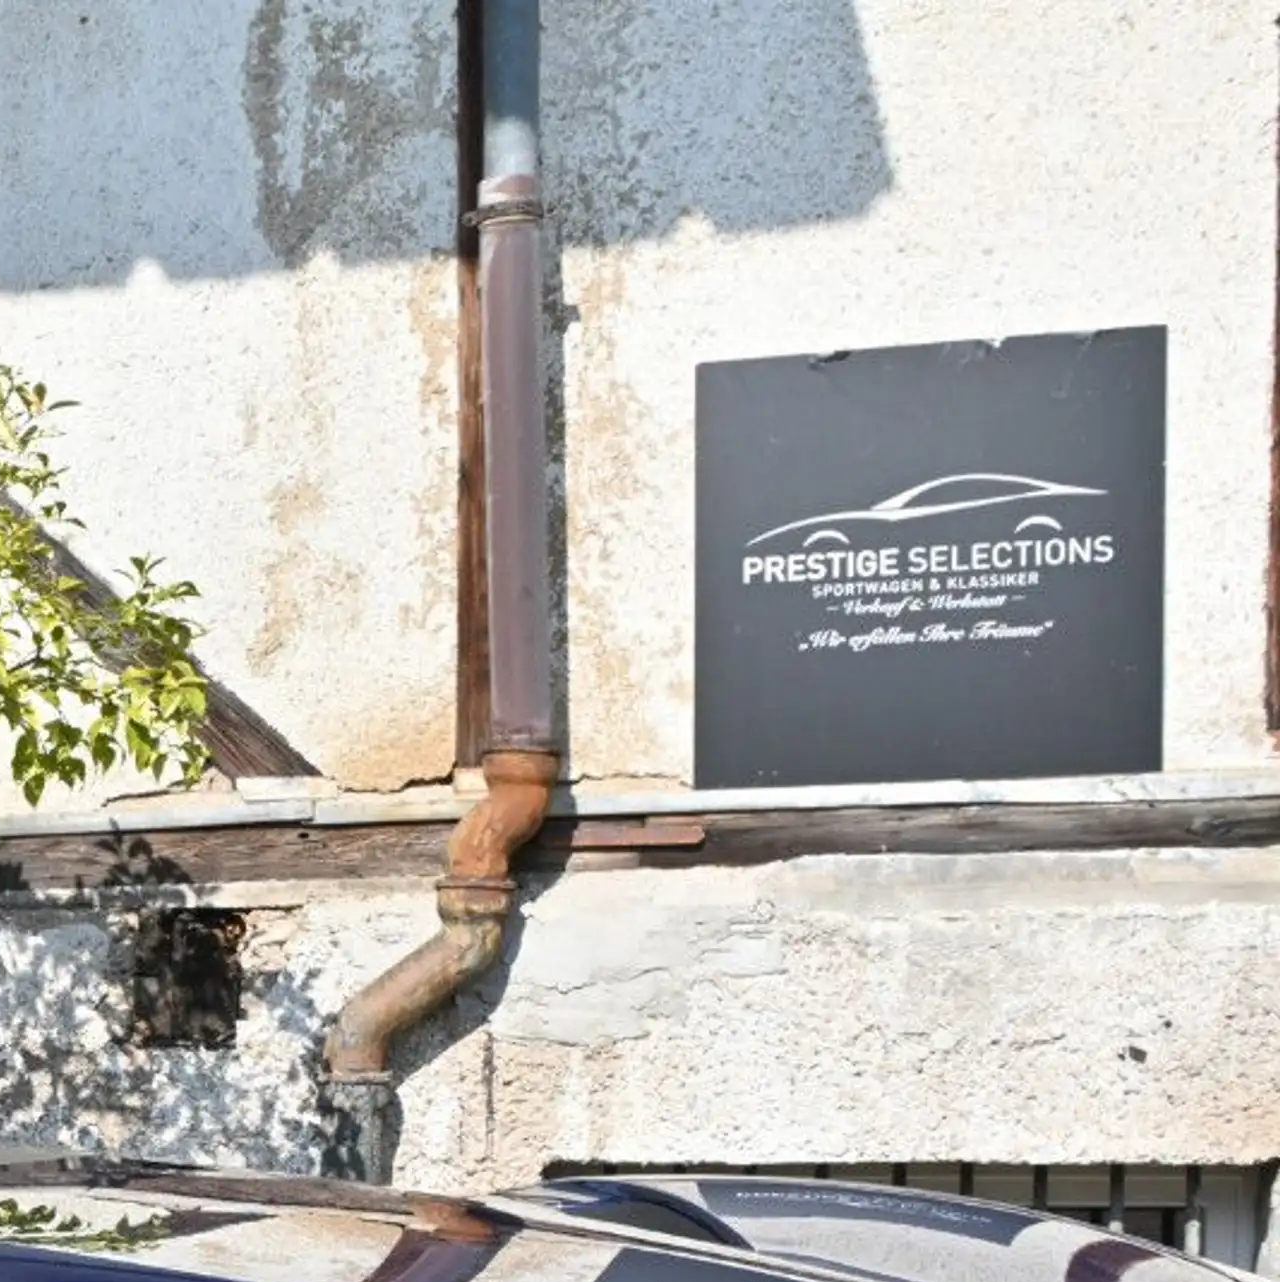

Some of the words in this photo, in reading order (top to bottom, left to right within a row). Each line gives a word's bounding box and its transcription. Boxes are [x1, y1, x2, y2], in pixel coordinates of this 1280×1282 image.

[742, 546, 900, 584] PRESTIGE
[907, 534, 1116, 574] SELECTIONS
[811, 578, 924, 599] SPORTWAGEN
[929, 577, 941, 591] &
[946, 571, 1040, 590] KLASSIKER
[919, 623, 966, 642] Ihre
